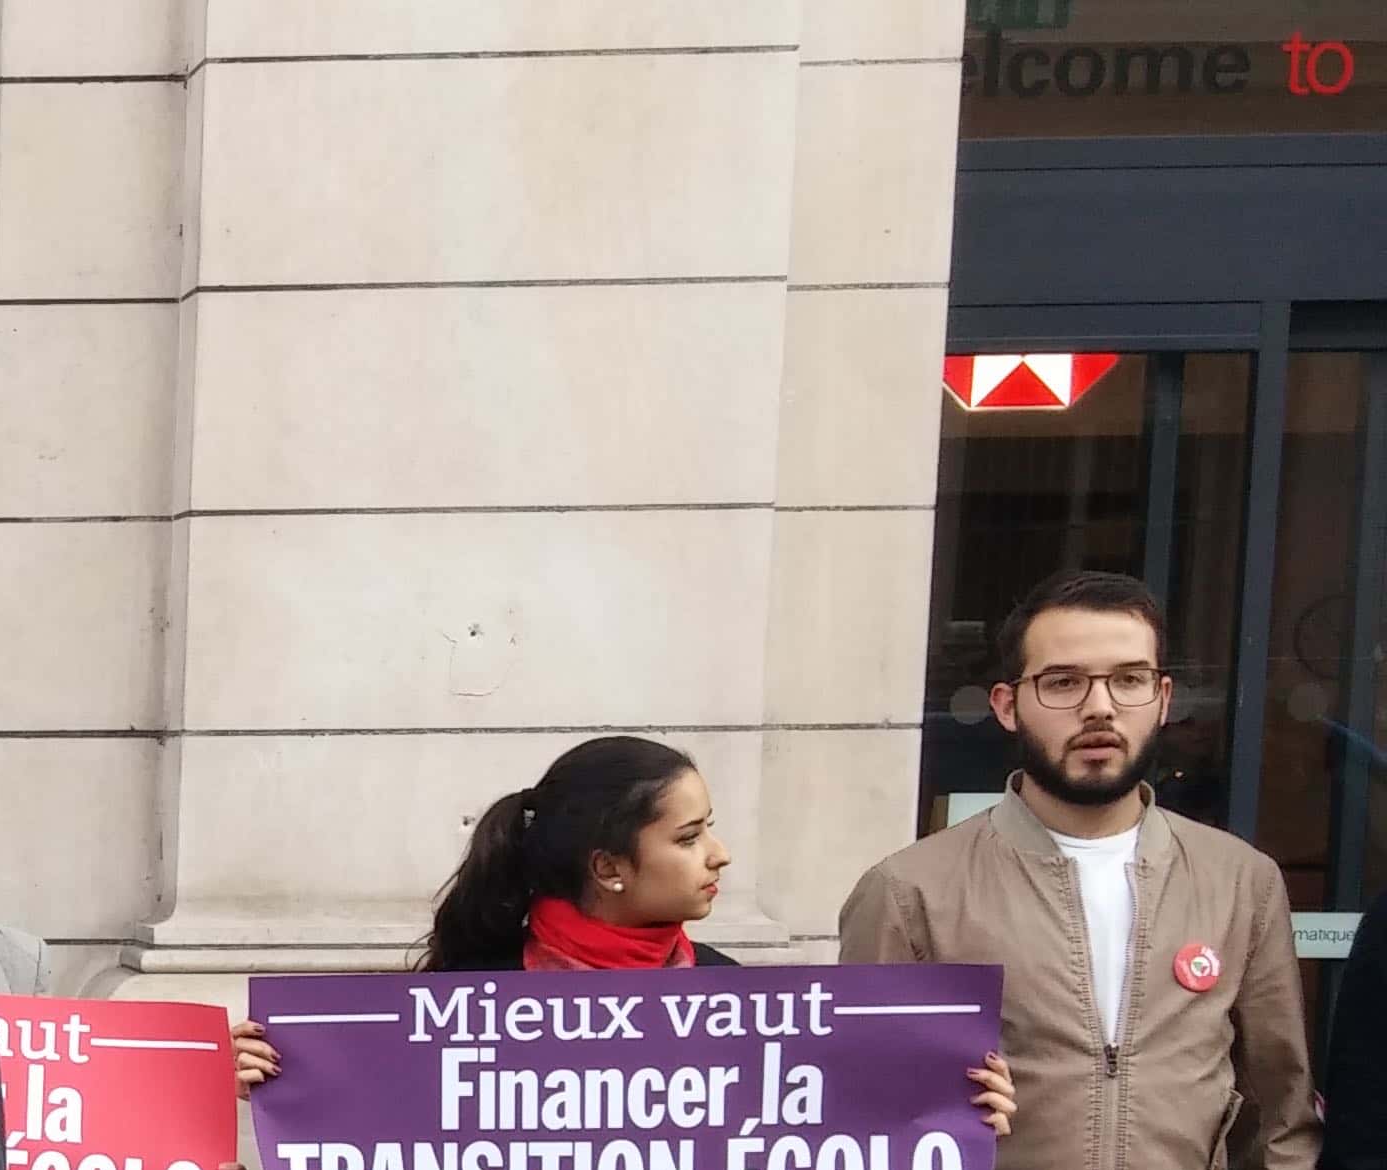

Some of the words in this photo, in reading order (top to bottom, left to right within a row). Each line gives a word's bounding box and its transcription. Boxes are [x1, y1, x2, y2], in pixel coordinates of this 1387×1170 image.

[1282, 29, 1355, 97] to
[409, 982, 644, 1042] Mieux
[661, 982, 833, 1037] vaut
[26, 1063, 82, 1143] la
[441, 1047, 740, 1130] Financer
[761, 1043, 823, 1125] la
